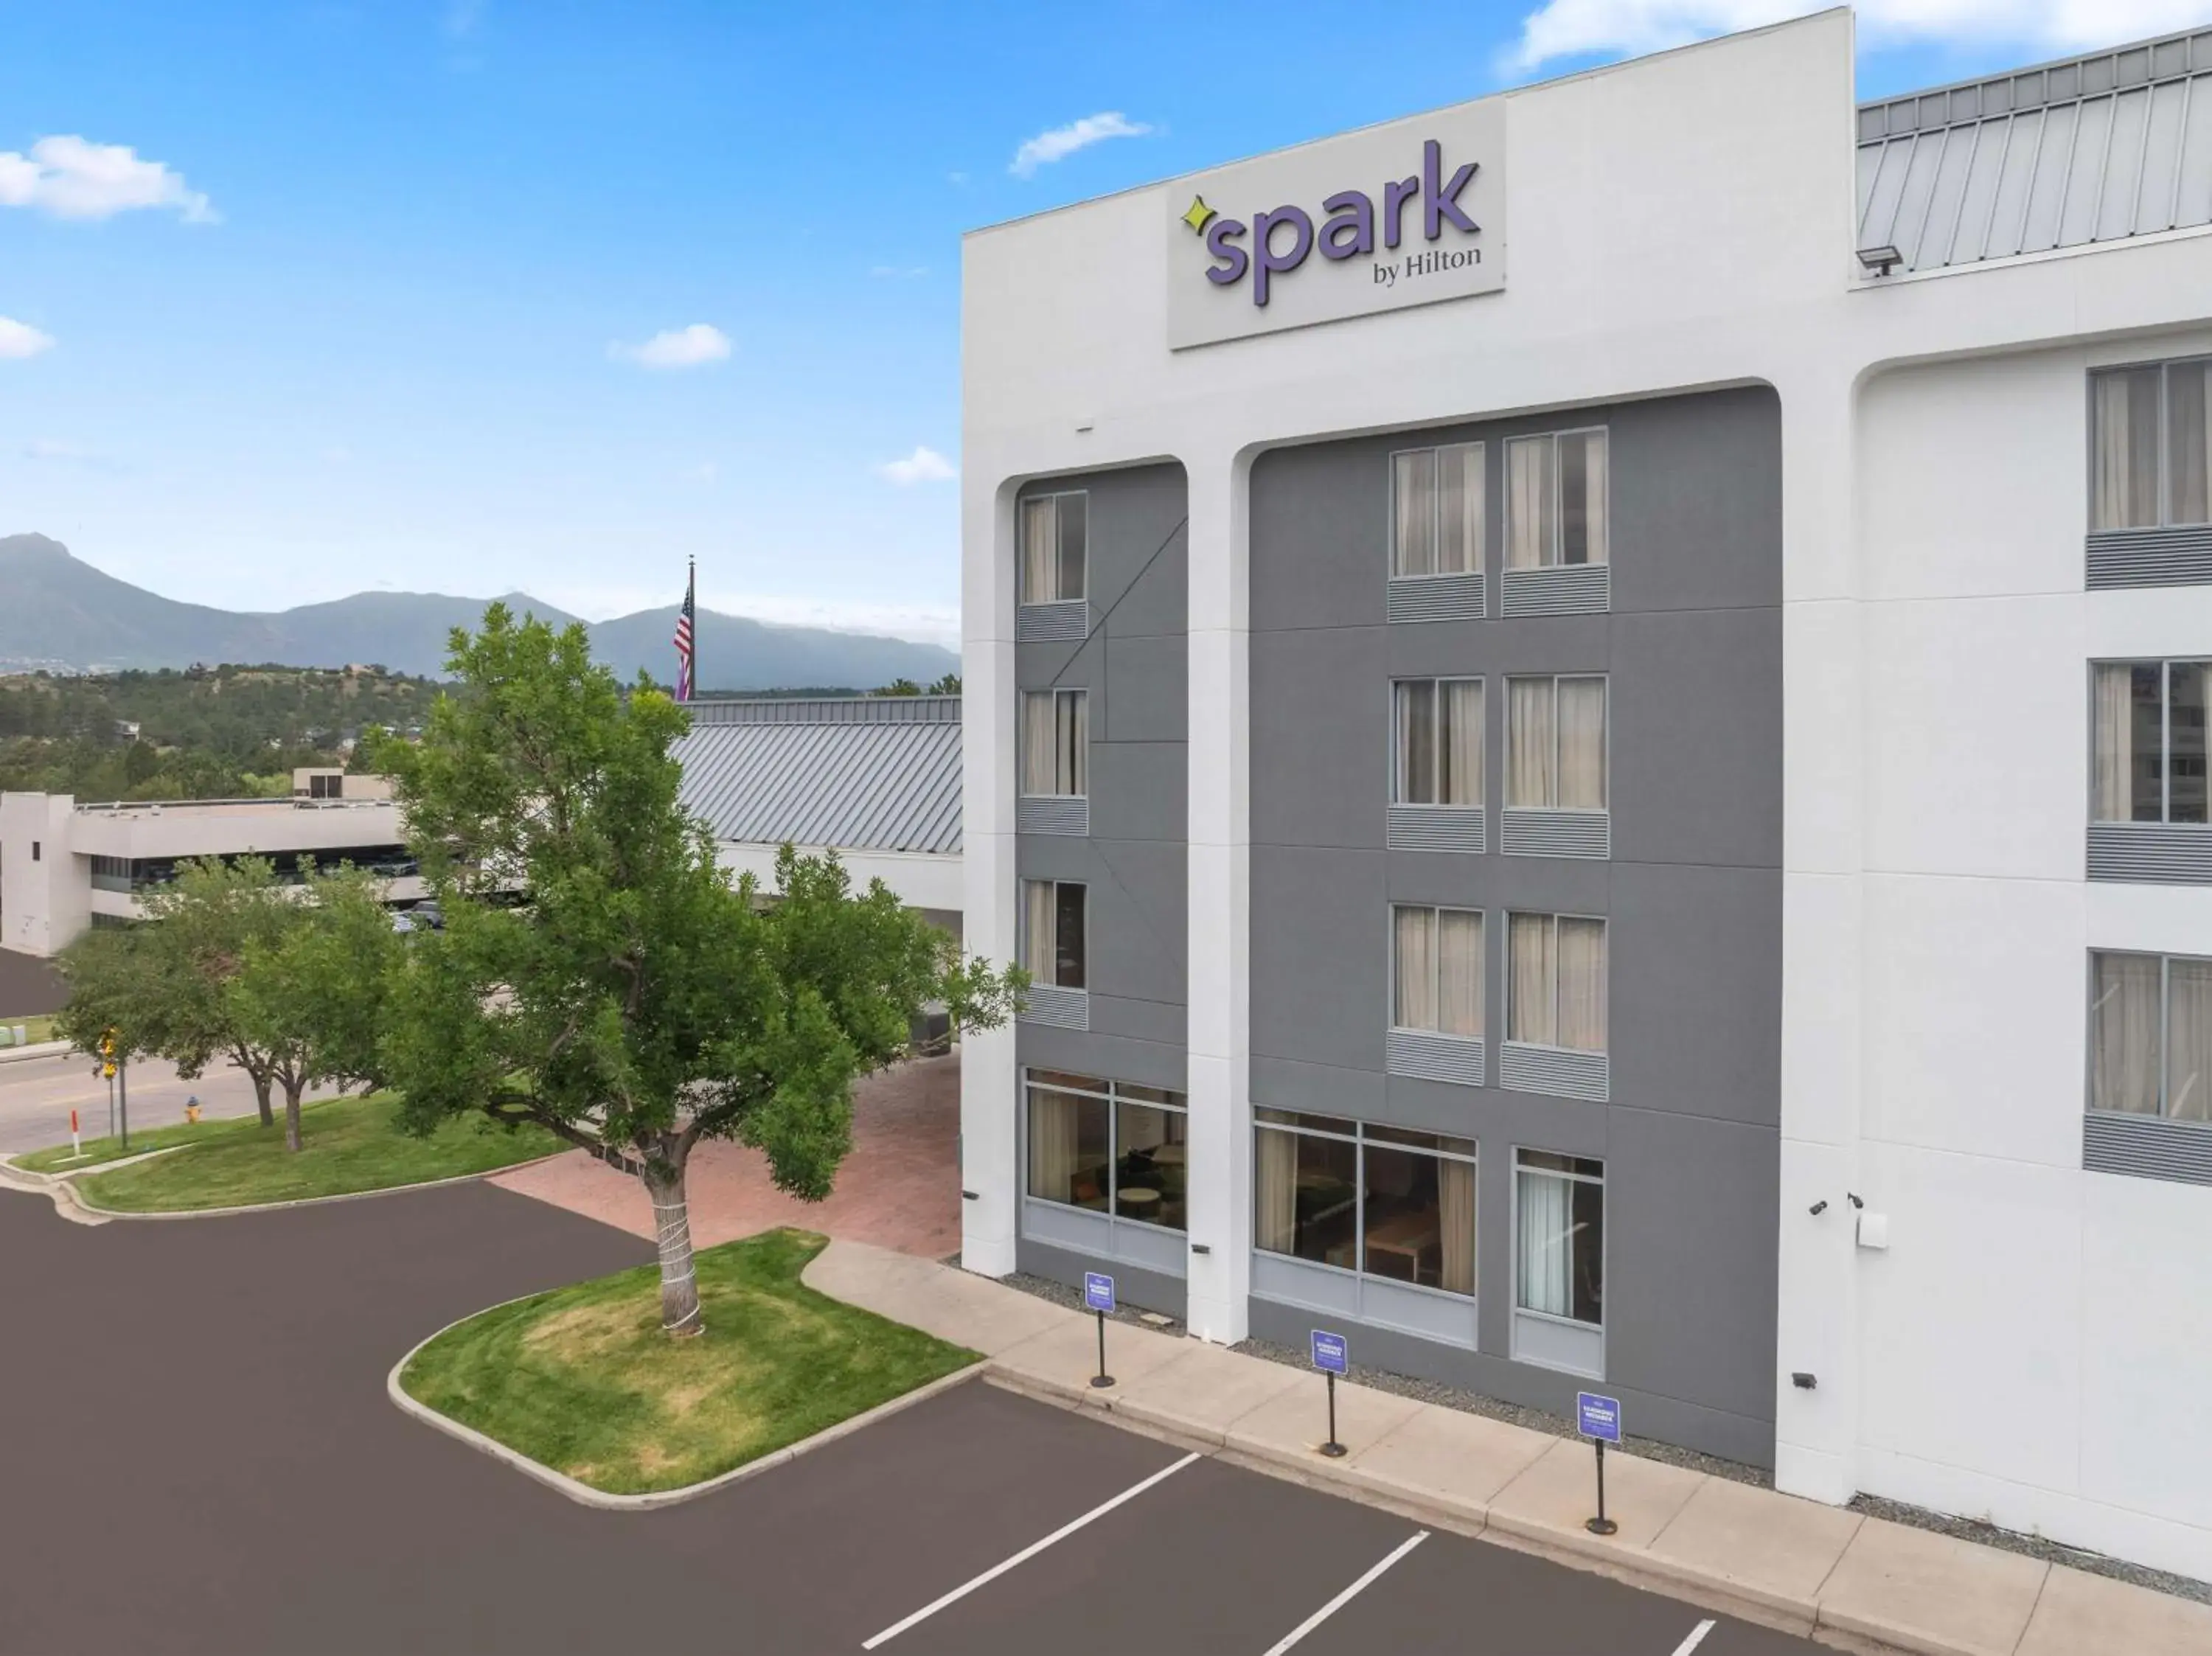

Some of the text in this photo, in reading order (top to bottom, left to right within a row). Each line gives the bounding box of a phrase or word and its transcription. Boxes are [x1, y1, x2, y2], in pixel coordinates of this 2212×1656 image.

[1206, 139, 1481, 307] spark
[1374, 248, 1481, 288] by Hilton
